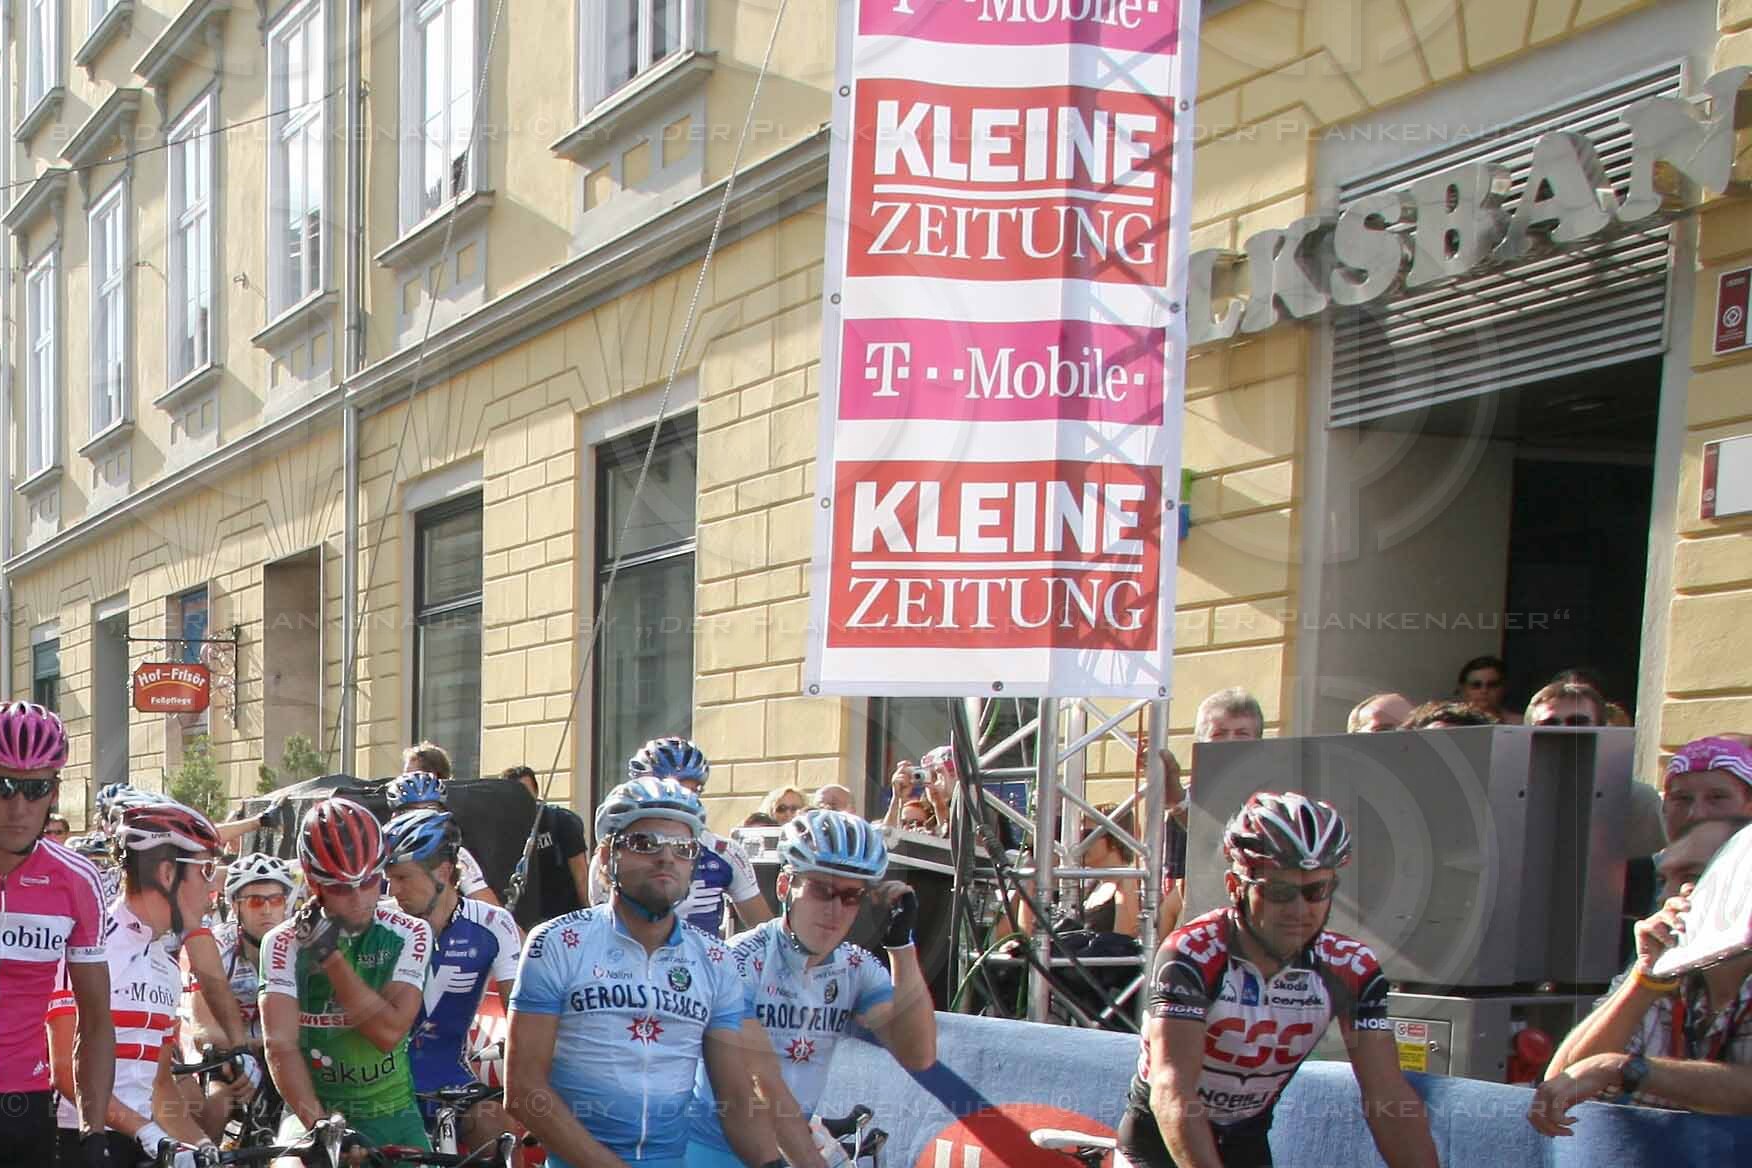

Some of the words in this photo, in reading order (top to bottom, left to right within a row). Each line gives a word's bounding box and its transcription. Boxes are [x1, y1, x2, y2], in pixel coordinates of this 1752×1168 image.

[874, 100, 1157, 188] KLEINE
[867, 201, 1155, 264] ZEITUNG
[851, 481, 1146, 555] KLEINE
[845, 576, 1145, 630] ZEITUNG
[1204, 1017, 1313, 1068] CSC
